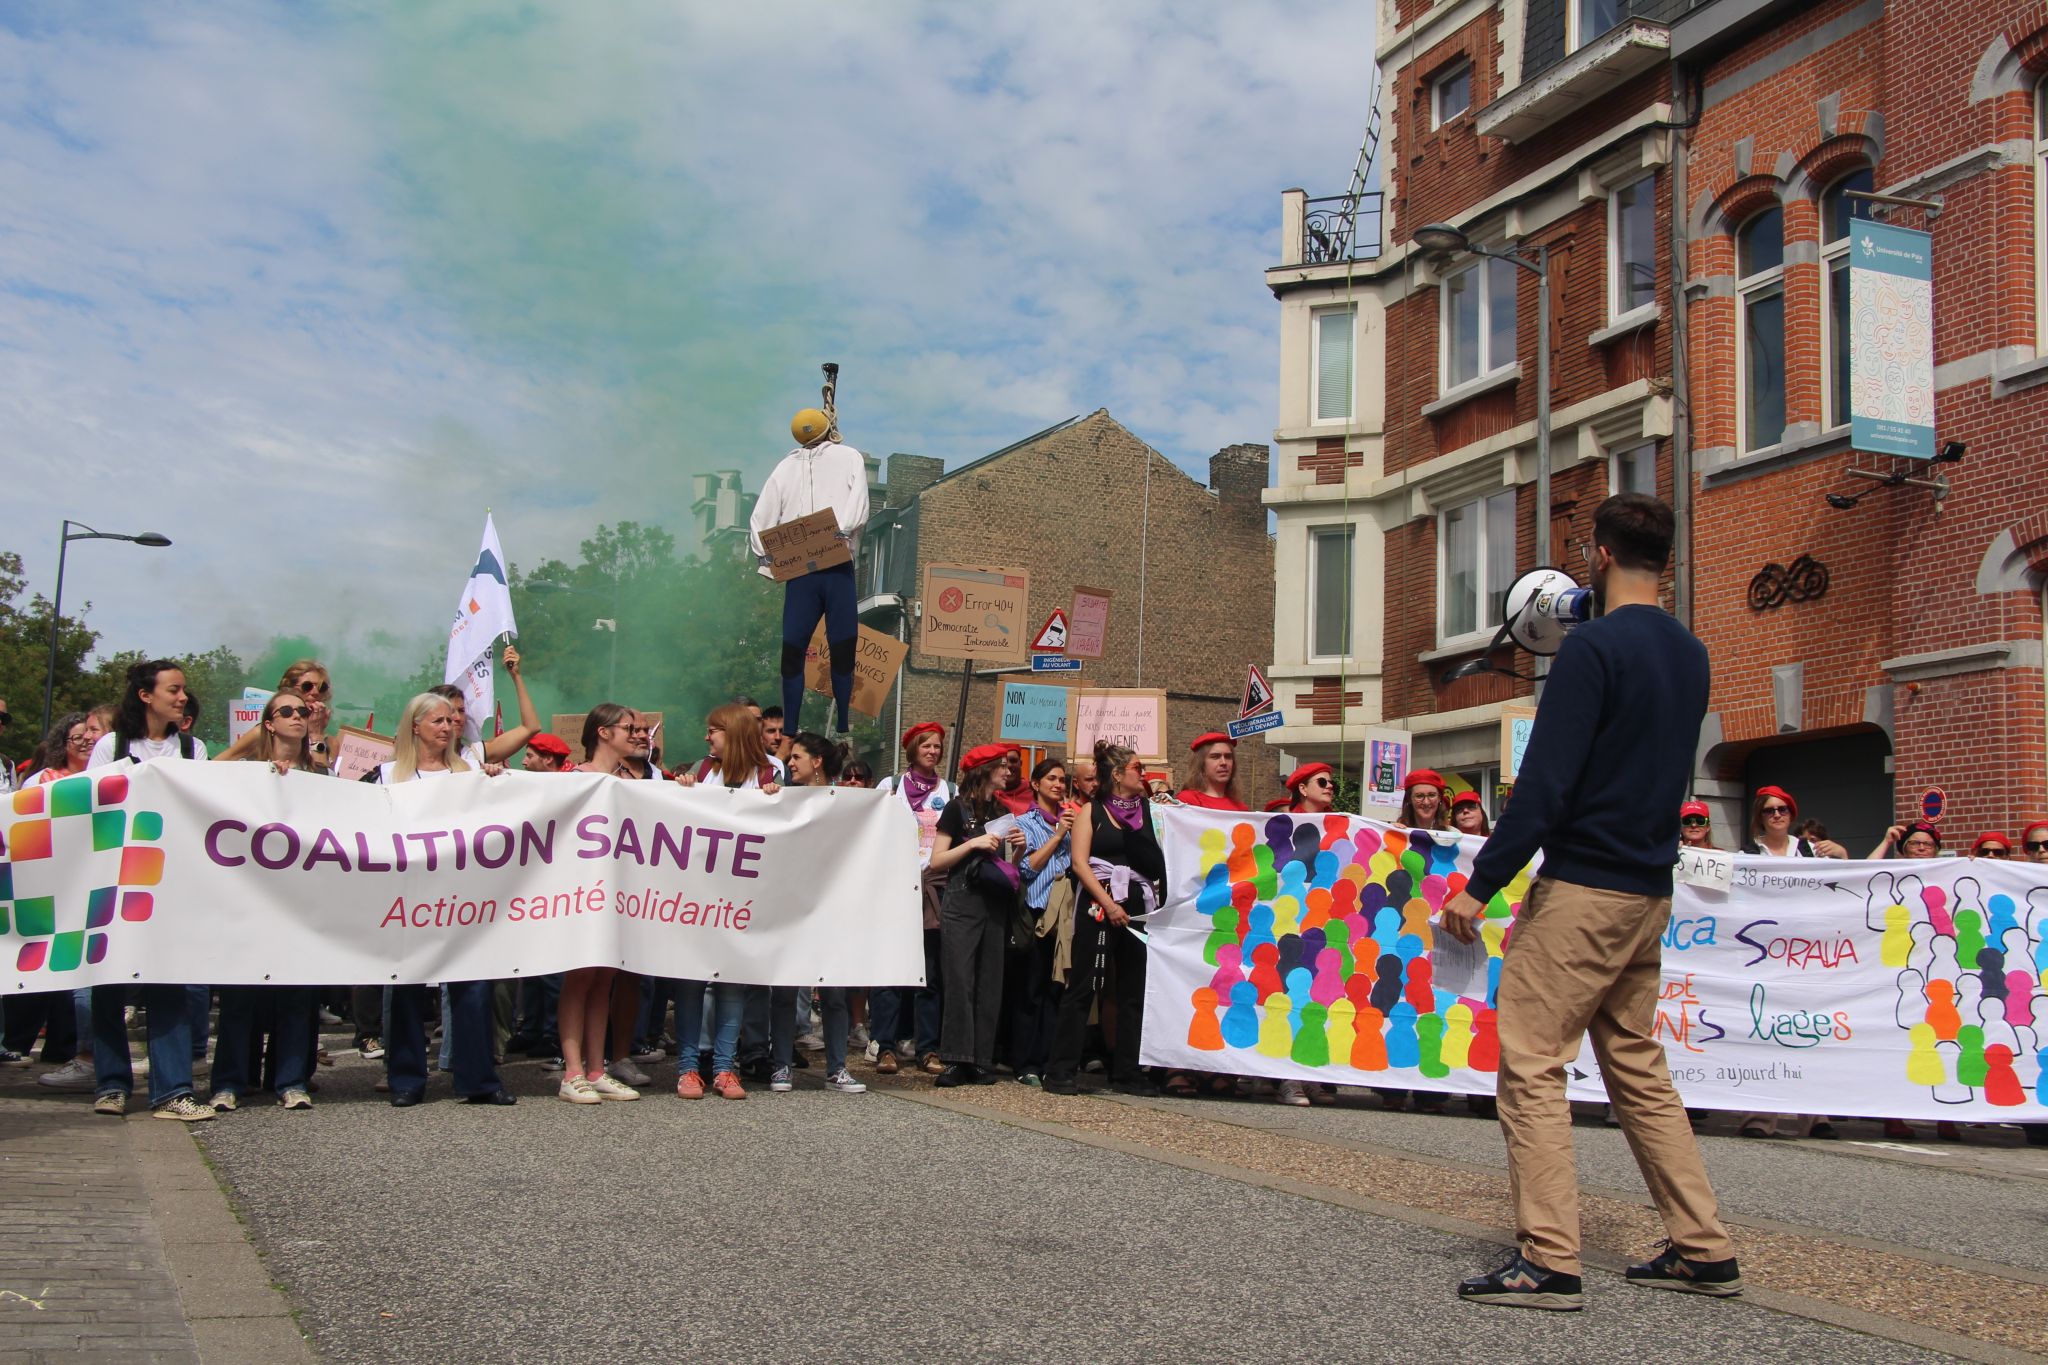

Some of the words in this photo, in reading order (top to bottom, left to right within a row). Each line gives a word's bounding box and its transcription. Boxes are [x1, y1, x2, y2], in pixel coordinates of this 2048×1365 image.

[965, 593, 992, 611] Error
[994, 599, 1015, 613] 404
[964, 635, 1009, 648] Introuvable
[1006, 690, 1026, 705] NON
[234, 710, 260, 721] TOUT
[1120, 706, 1130, 717] du
[1005, 713, 1020, 728] OUI
[1236, 724, 1255, 735] DROIT
[1255, 720, 1278, 730] DEVANT
[204, 819, 557, 873] COALITION
[577, 815, 766, 879] SANTE
[1693, 855, 1727, 880] APE
[1762, 873, 1825, 891] personnes
[380, 895, 497, 928] Action
[508, 881, 606, 922] santé
[616, 890, 752, 931] solidarité
[1715, 1062, 1803, 1087] aujourd'hui
